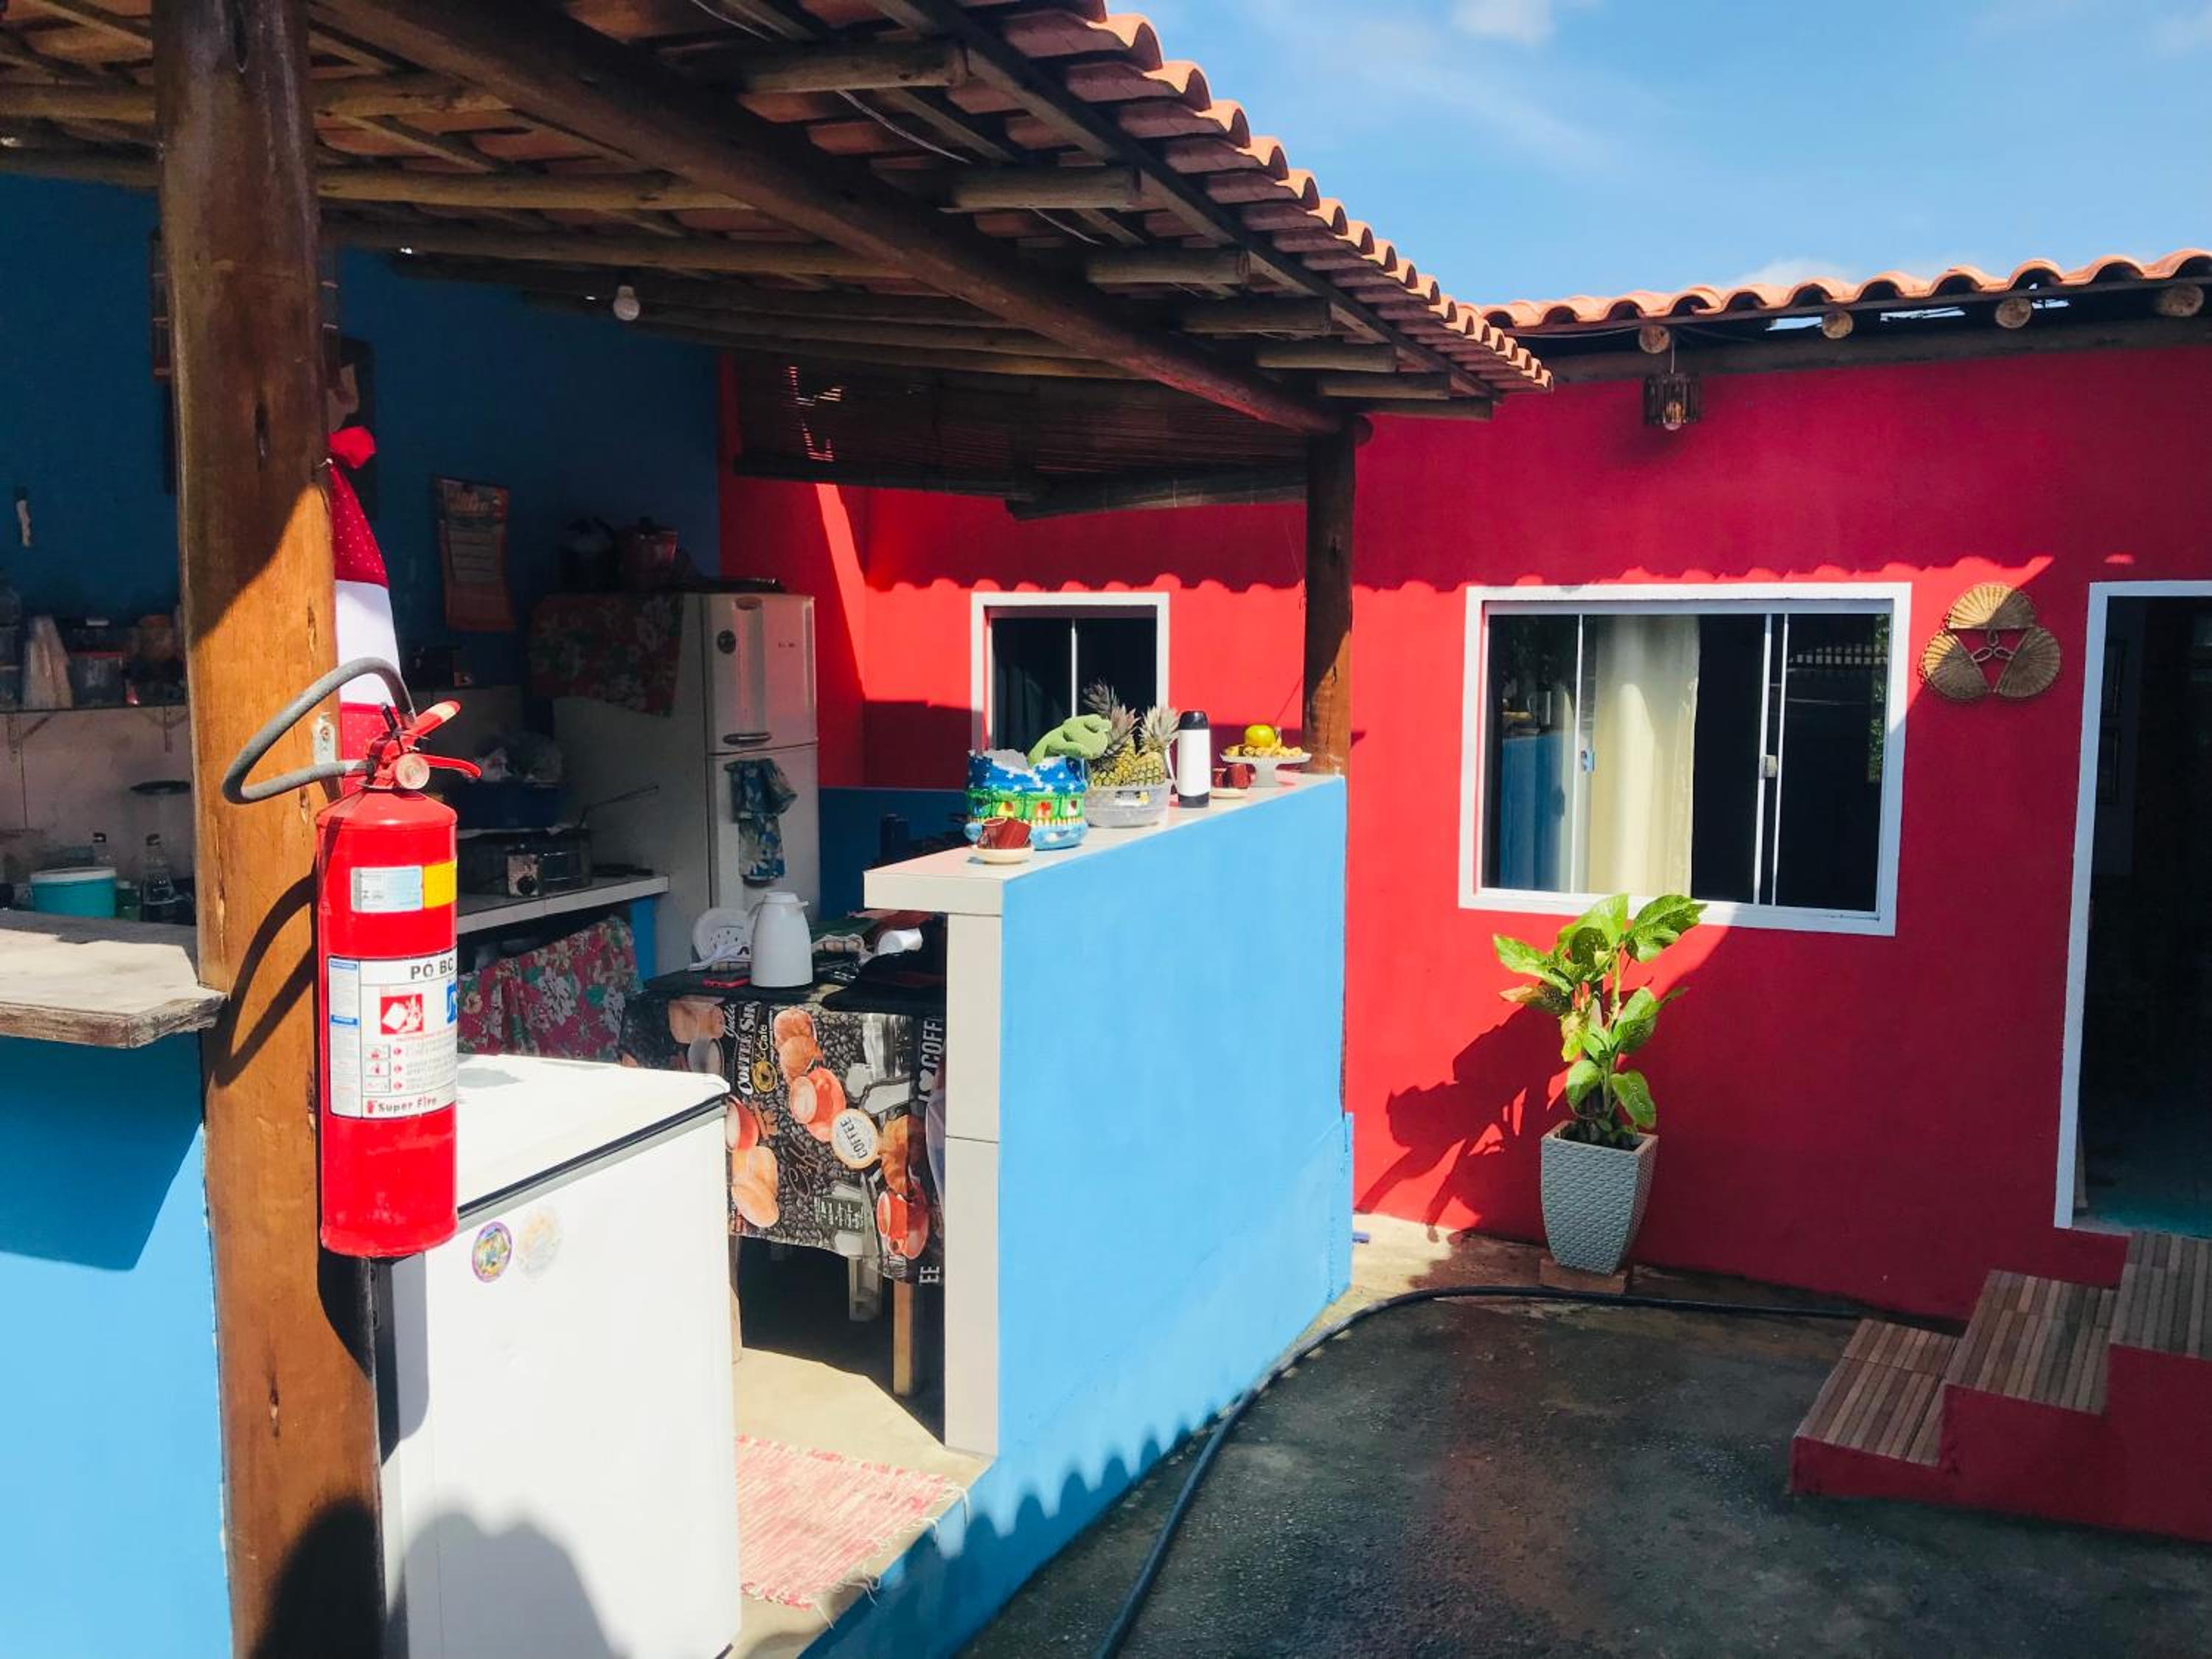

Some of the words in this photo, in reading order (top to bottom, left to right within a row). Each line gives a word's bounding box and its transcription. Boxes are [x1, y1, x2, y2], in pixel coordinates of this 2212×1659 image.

[737, 1033, 754, 1095] COFFEE
[921, 1016, 943, 1068] COFF
[378, 1102, 413, 1114] Super
[840, 1116, 868, 1158] COFFEE
